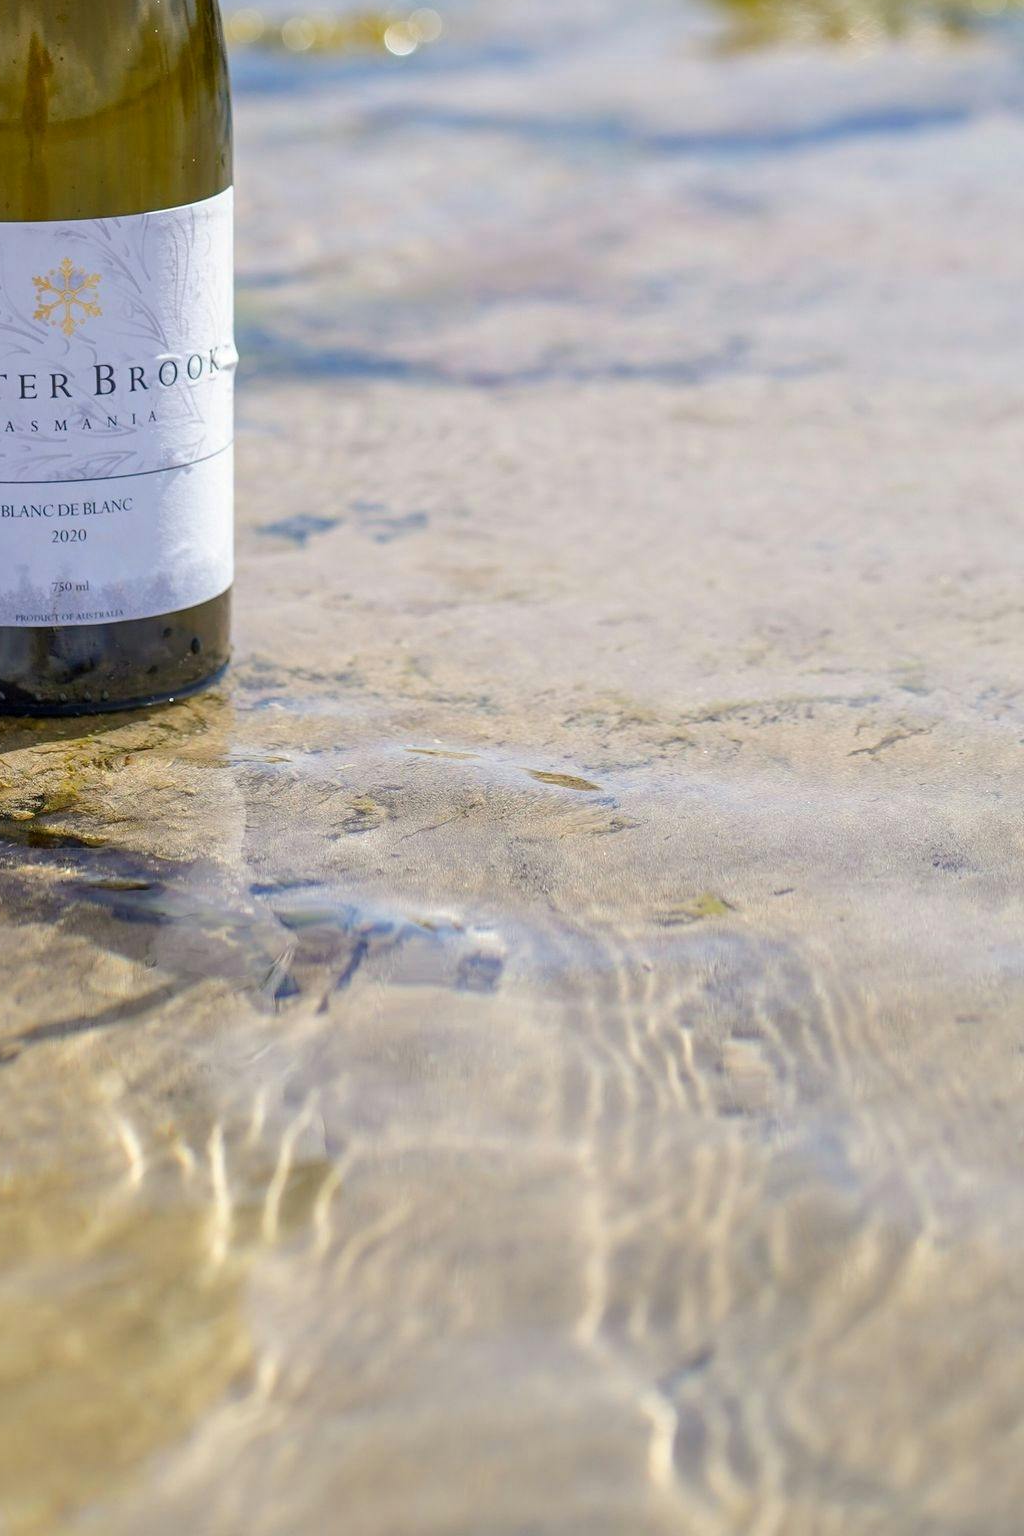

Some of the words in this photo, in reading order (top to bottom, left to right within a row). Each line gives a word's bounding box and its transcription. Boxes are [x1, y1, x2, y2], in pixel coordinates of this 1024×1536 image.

[93, 345, 220, 396] BROOK
[1, 503, 55, 518] BLANC
[58, 502, 80, 517] DE
[82, 497, 133, 515] BLANC
[51, 528, 87, 543] 2020
[50, 581, 73, 593] 750
[76, 579, 90, 592] ml
[16, 613, 60, 623] PRODUCT
[61, 613, 74, 622] OF
[77, 609, 125, 621] AUSTRALIA
